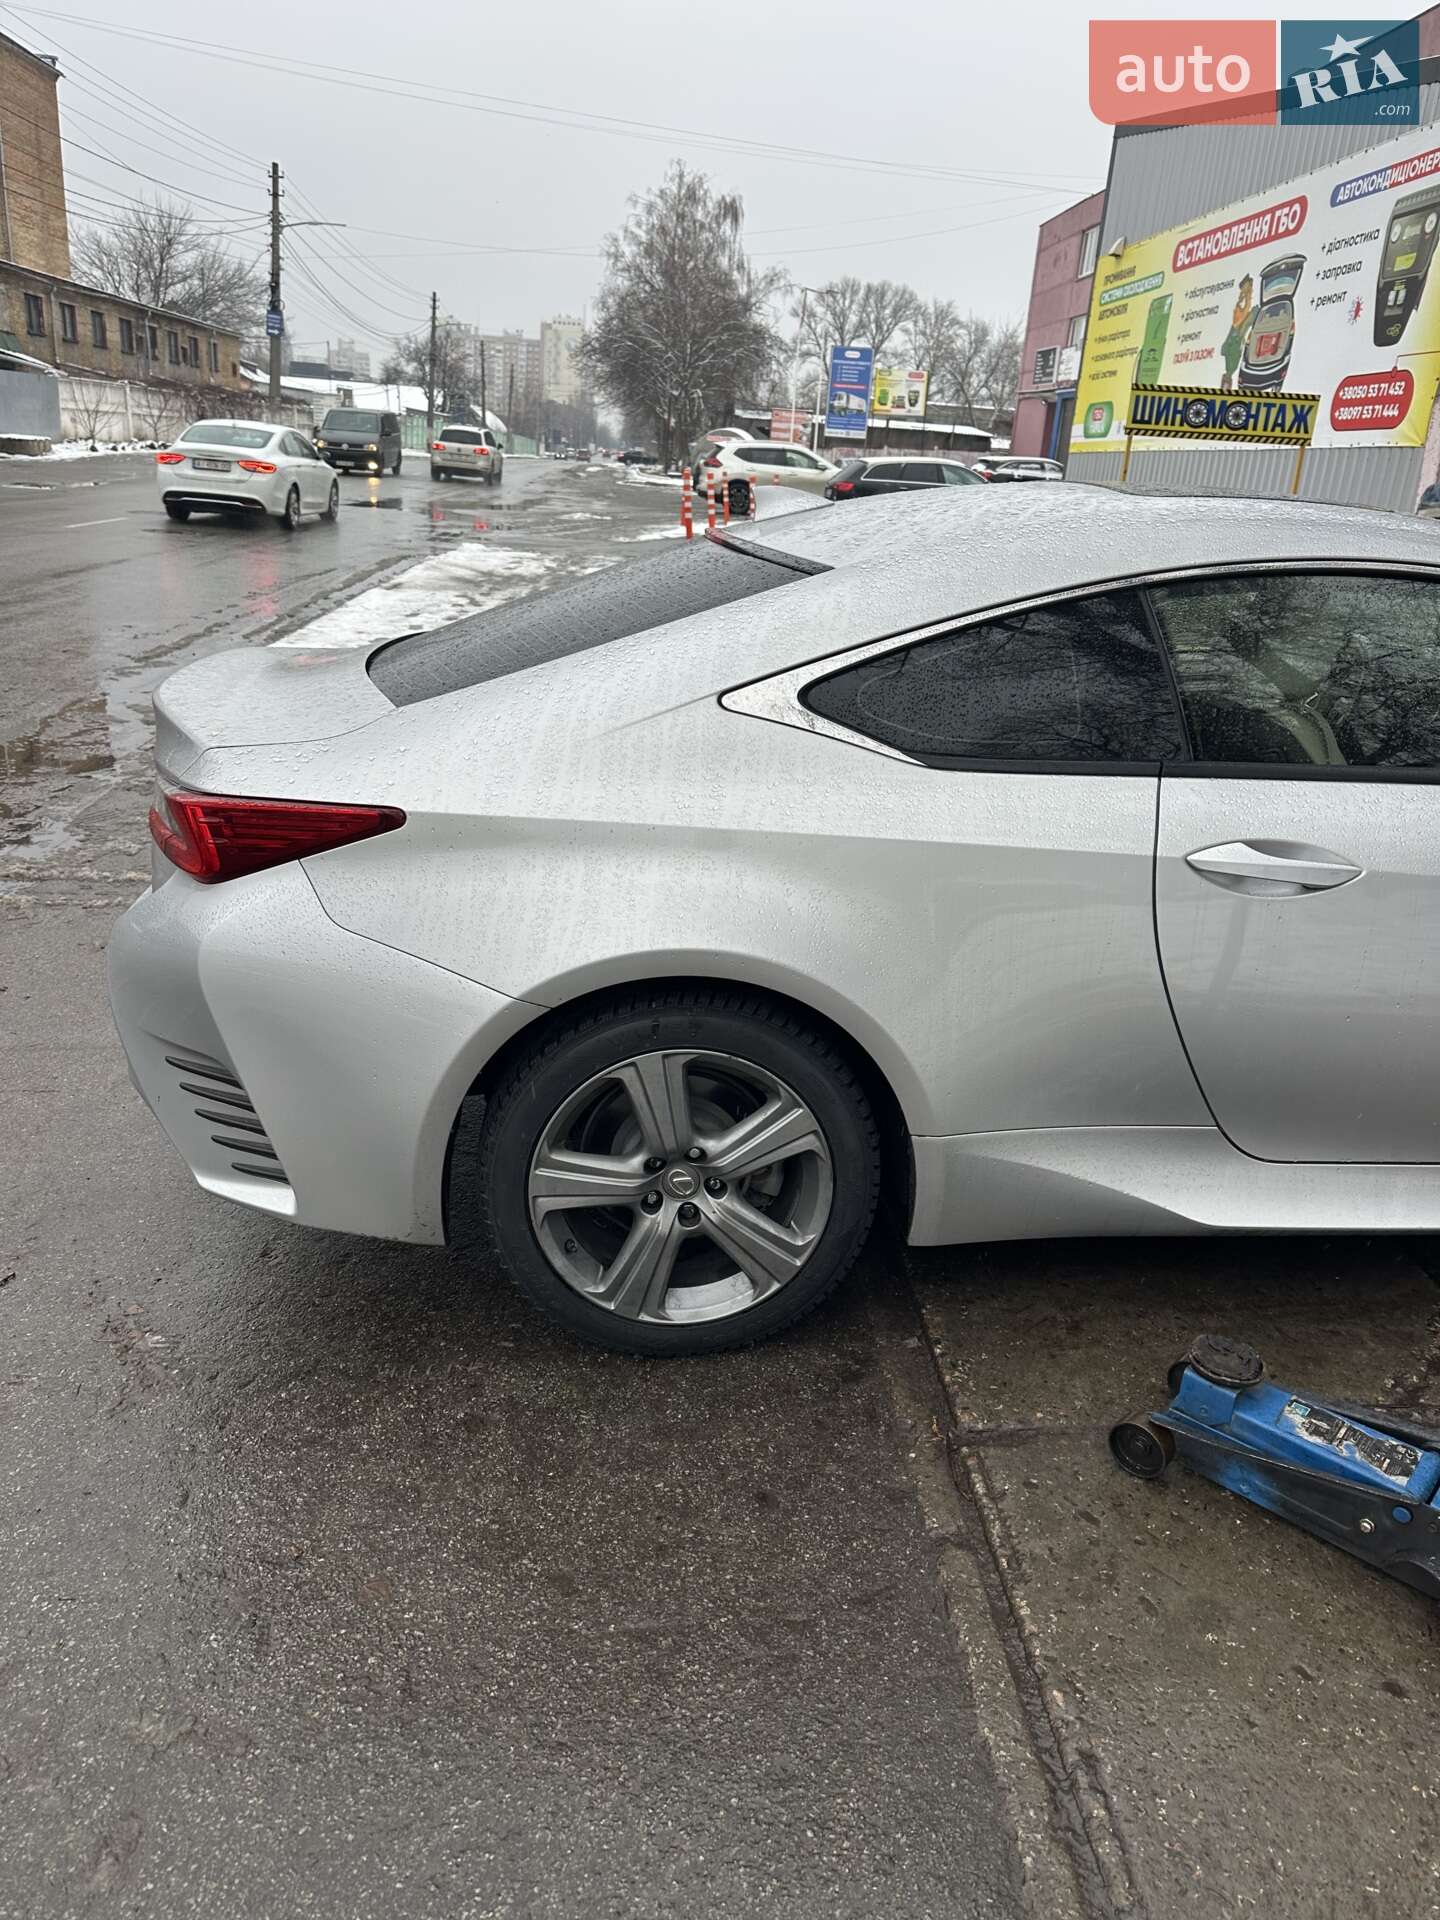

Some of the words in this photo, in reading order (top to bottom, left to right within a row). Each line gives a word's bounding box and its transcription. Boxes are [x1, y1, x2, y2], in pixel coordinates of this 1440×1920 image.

[1336, 151, 1440, 202] АВТОКОНДИЦІОНЕР
[1176, 213, 1273, 267] ВСТАНОВЛЕННЯ
[1271, 203, 1301, 236] ГБО
[1326, 228, 1380, 255] діагностика
[1321, 260, 1362, 281] заправка
[1315, 291, 1347, 310] ремонт
[1339, 385, 1367, 399] +38050
[1368, 384, 1379, 397] 53
[1379, 383, 1388, 396] 71
[1389, 381, 1405, 395] 452
[1131, 394, 1314, 434] ШИНОМОНТАЖ
[1362, 405, 1373, 418] 53
[1373, 405, 1382, 418] 71
[1382, 403, 1399, 417] 444
